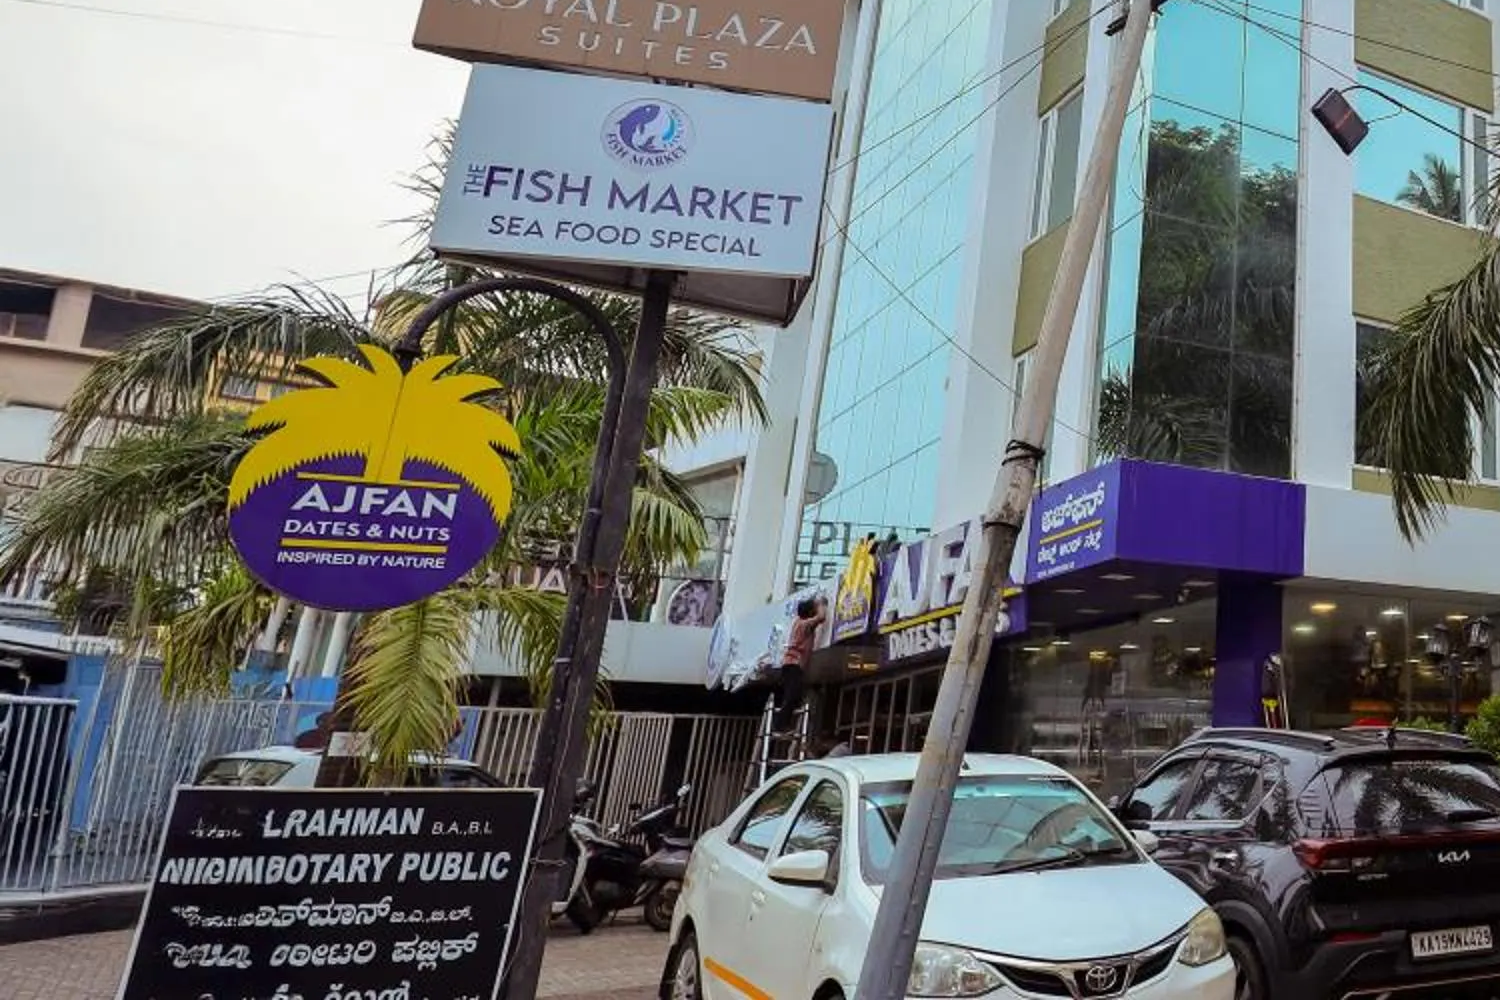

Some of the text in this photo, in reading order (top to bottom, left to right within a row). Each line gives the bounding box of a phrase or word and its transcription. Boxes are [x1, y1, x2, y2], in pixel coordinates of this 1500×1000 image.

[541, 26, 729, 70] SUITES
[654, 2, 817, 55] PLAZA
[463, 164, 803, 226] THE FISH MARKET
[488, 215, 761, 257] SEA FOOD SPECIAL
[290, 482, 458, 520] AJFAN
[283, 519, 451, 541] DATES & NUTS
[276, 551, 447, 569] INSPIRED BY NATURE
[889, 619, 938, 661] DATES
[397, 851, 512, 883] PUBLIC
